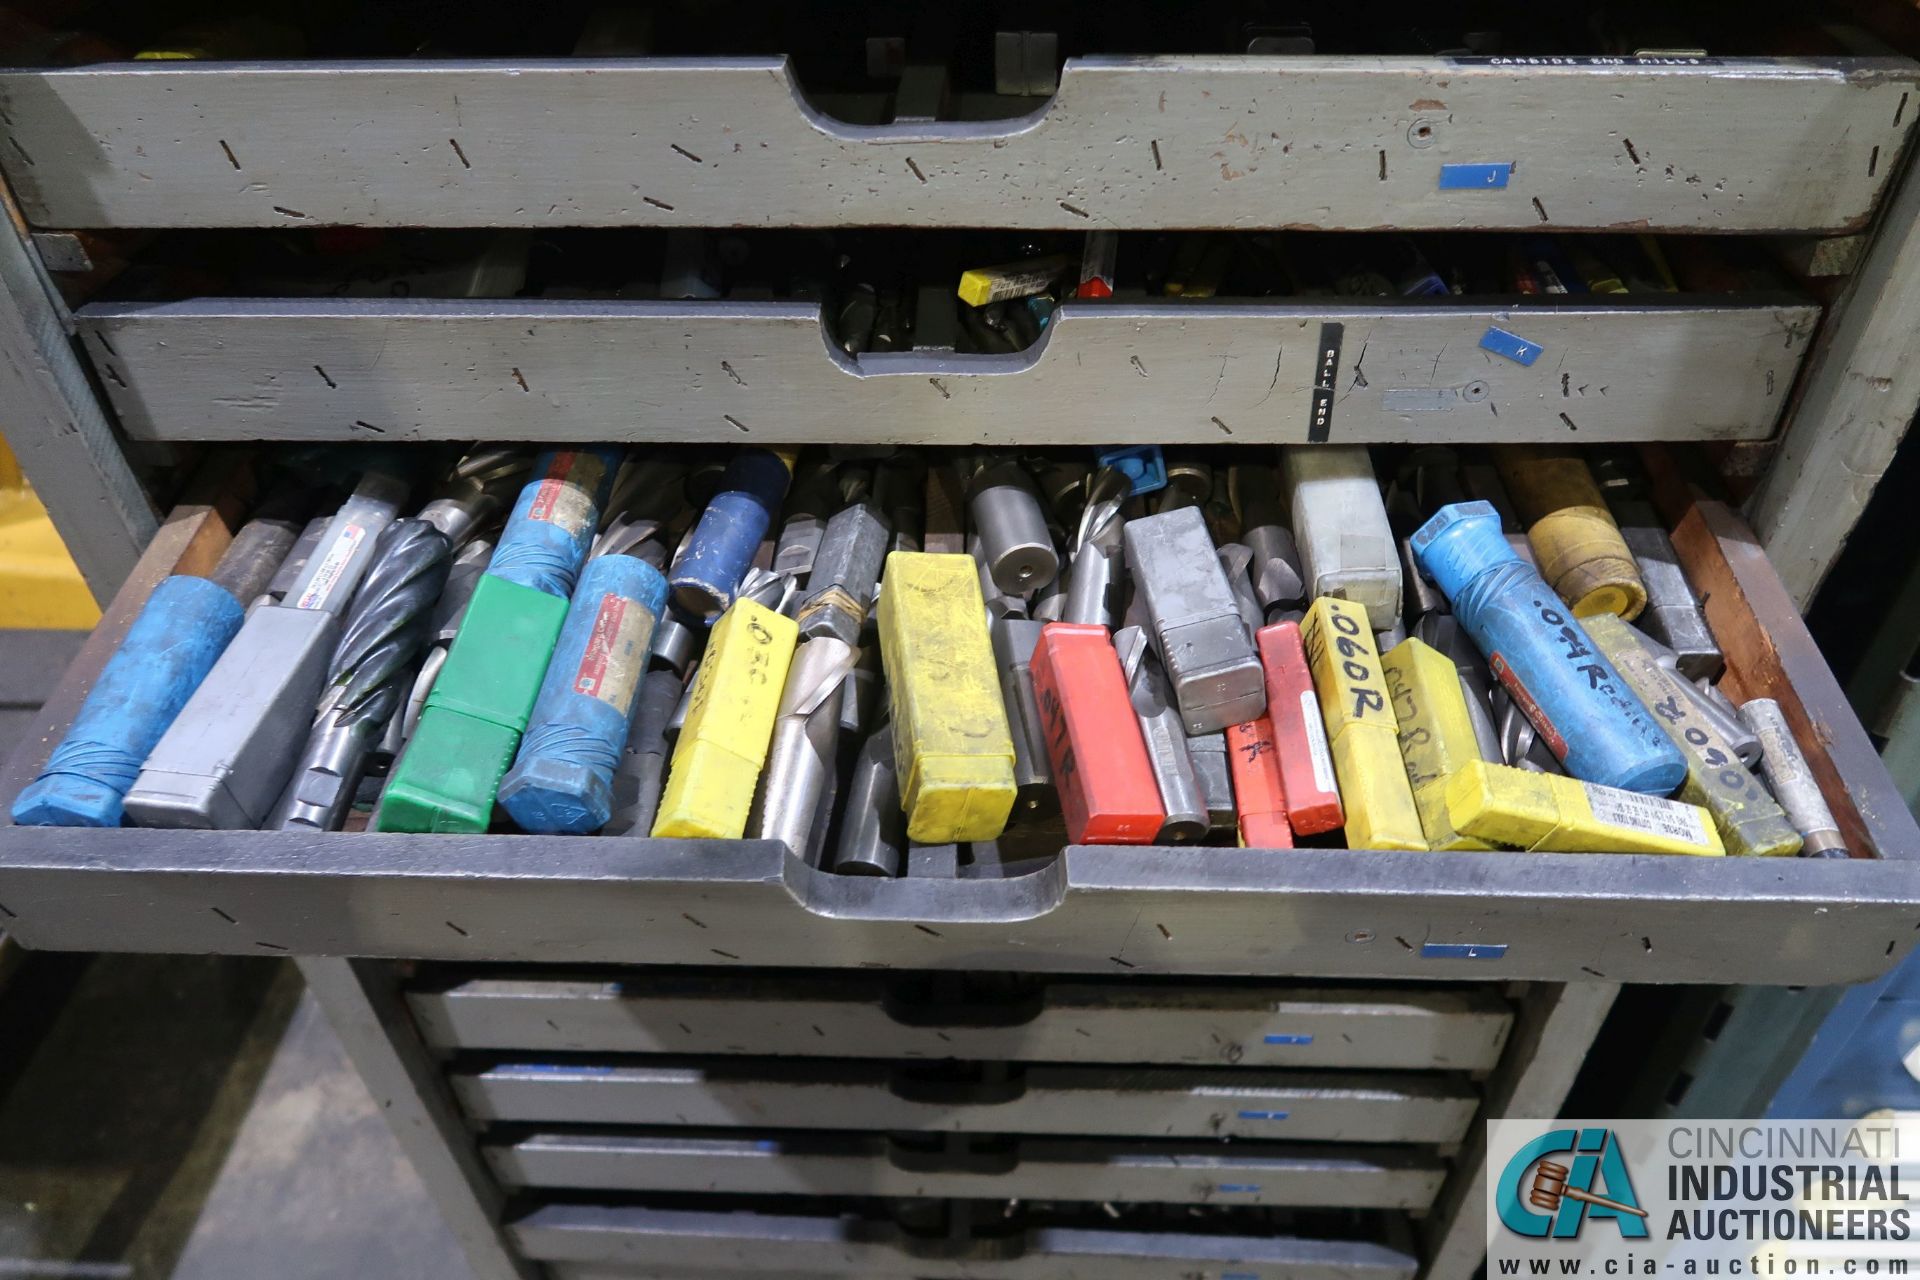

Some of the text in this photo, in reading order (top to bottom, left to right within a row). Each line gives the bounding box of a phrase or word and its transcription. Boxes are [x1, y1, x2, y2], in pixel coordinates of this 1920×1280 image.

[1490, 57, 1699, 65] CARBIDE END MILLS
[1487, 169, 1497, 183] J
[1515, 344, 1528, 357] K
[1316, 349, 1335, 426] BALL END
[1467, 948, 1477, 958] L
